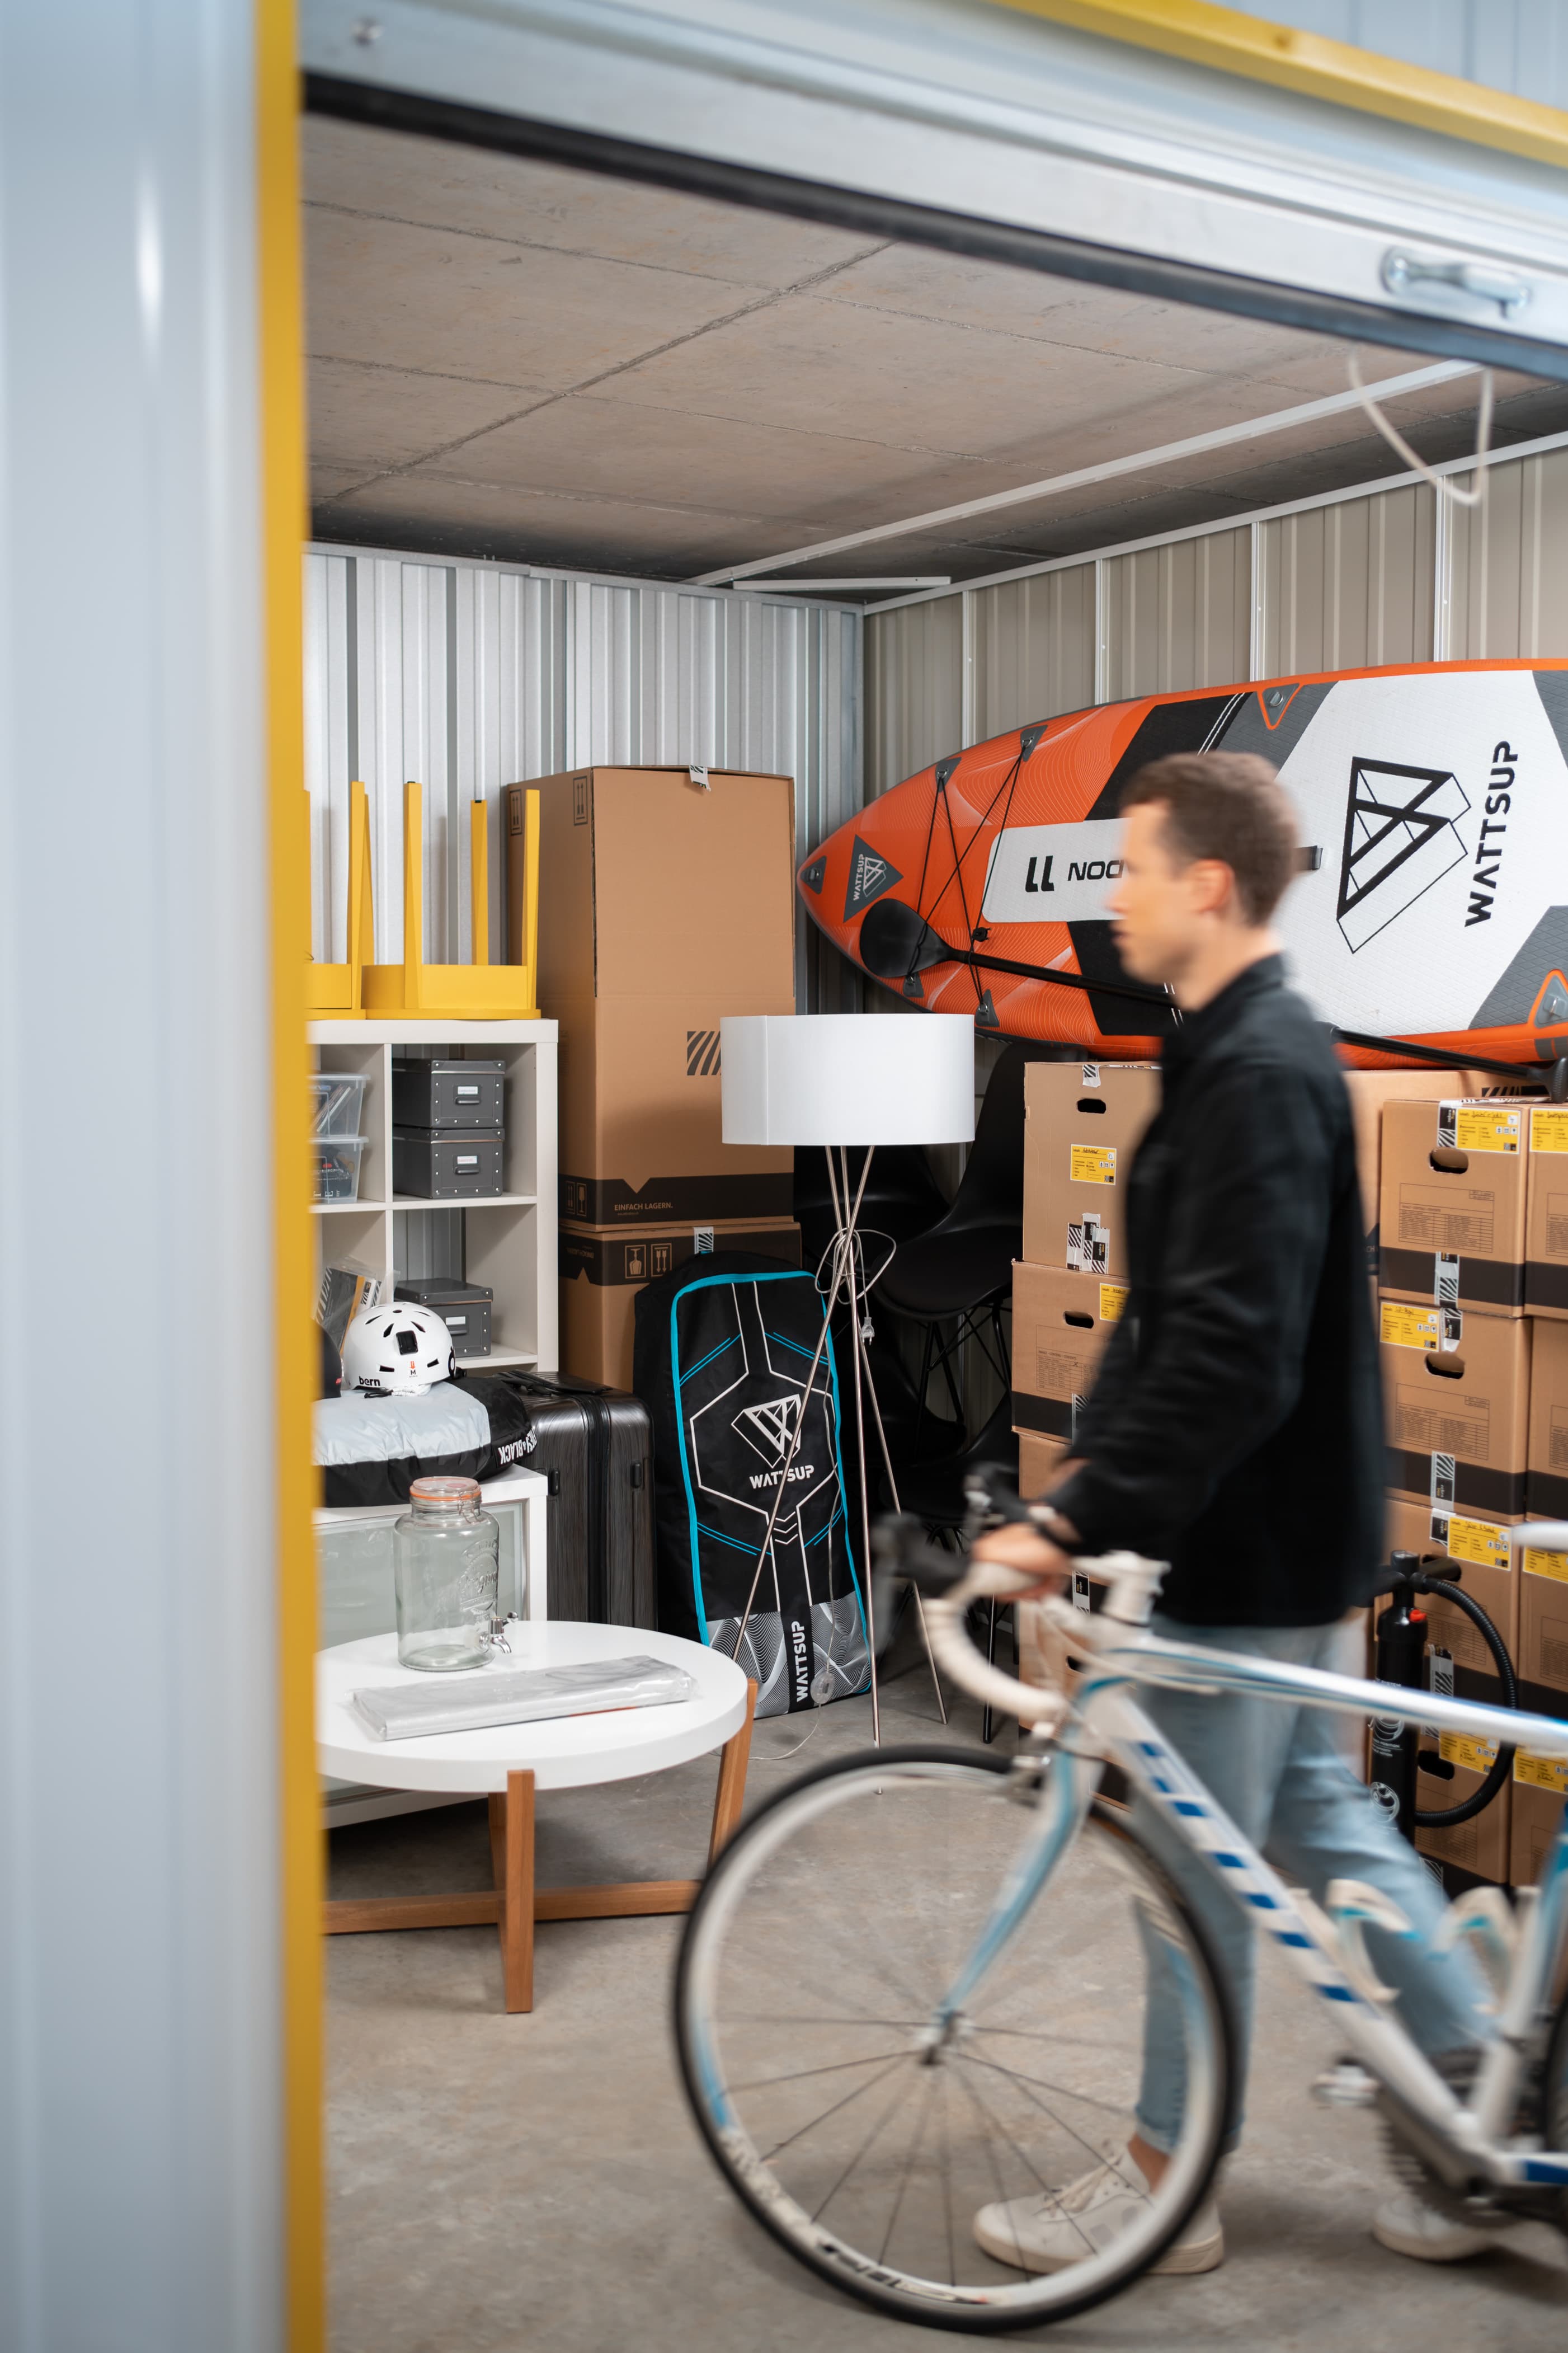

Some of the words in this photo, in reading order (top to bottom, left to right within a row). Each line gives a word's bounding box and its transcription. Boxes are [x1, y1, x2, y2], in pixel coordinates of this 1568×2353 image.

[1465, 741, 1518, 927] WATTSUP
[853, 854, 865, 901] WATTSUP
[359, 1375, 381, 1387] bern
[791, 1621, 808, 1702] WATTSUP
